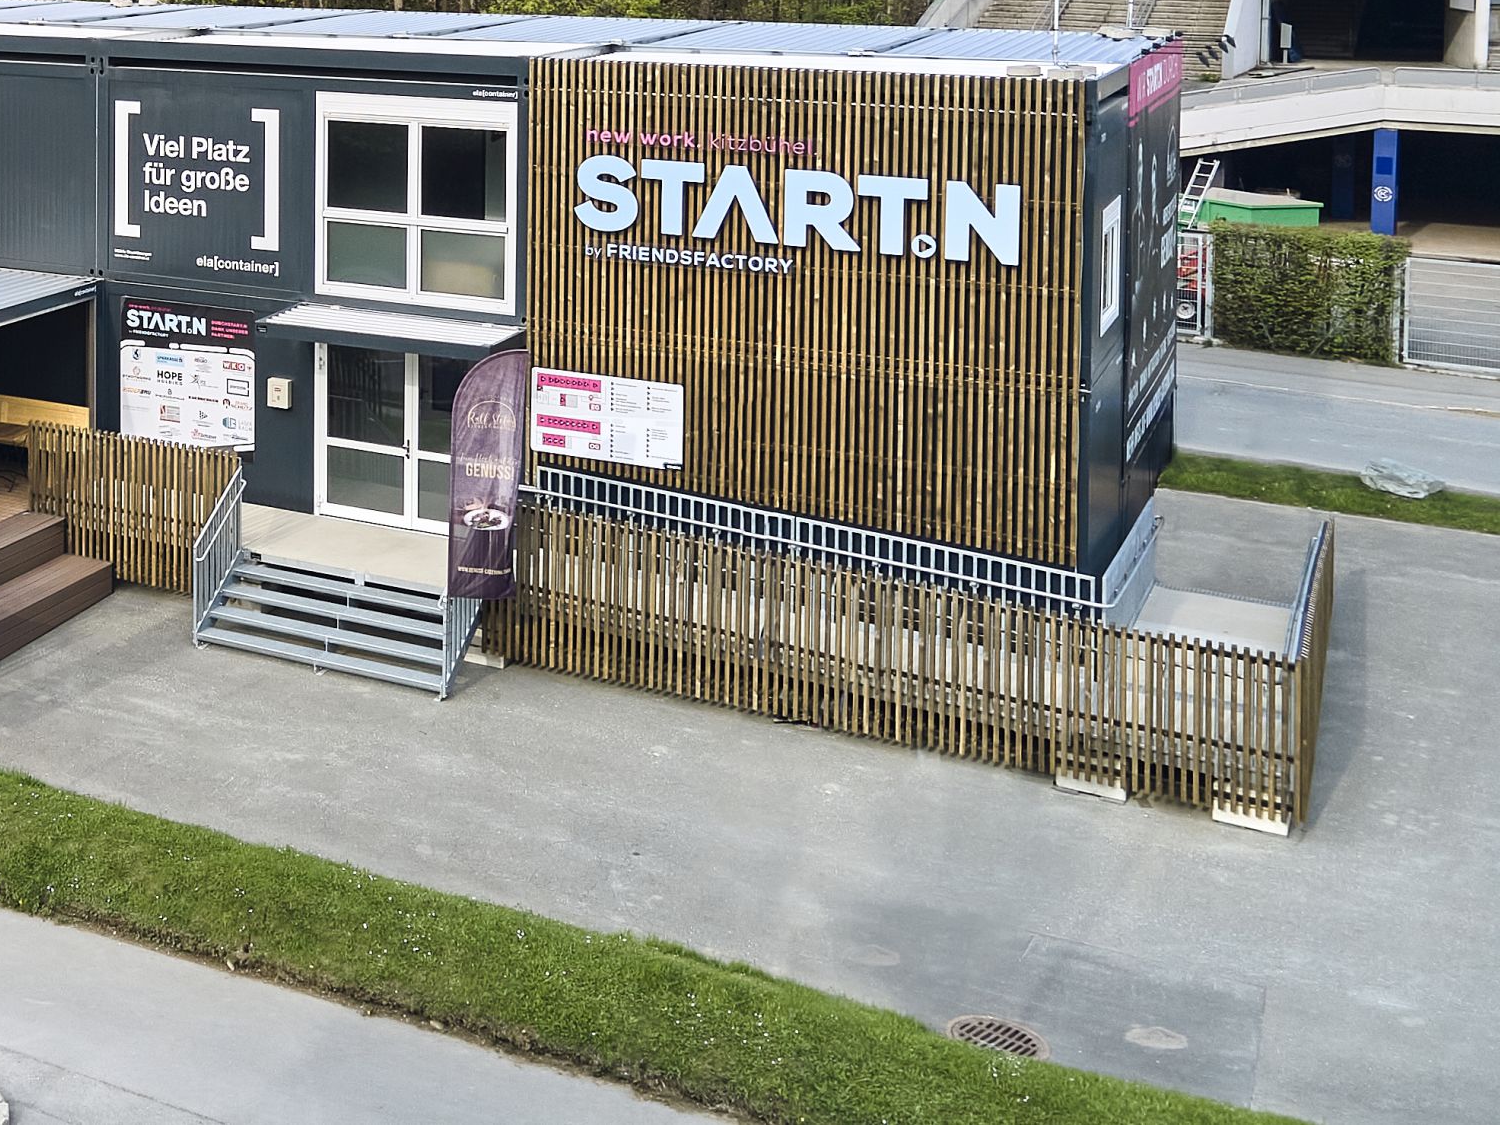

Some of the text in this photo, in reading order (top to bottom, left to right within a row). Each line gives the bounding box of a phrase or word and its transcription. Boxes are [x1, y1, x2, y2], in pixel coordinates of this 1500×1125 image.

[473, 90, 519, 100] ela[container]
[143, 133, 251, 163] Viel Platz
[586, 128, 631, 144] new
[640, 131, 701, 148] work.
[143, 162, 250, 193] für große
[144, 189, 207, 217] Ideen
[196, 255, 280, 277] ela[container]
[585, 243, 794, 274] by FRIENDSFACTORY
[157, 370, 183, 381] HOPE
[223, 361, 245, 371] WKO
[465, 462, 515, 481] GENUSS!
